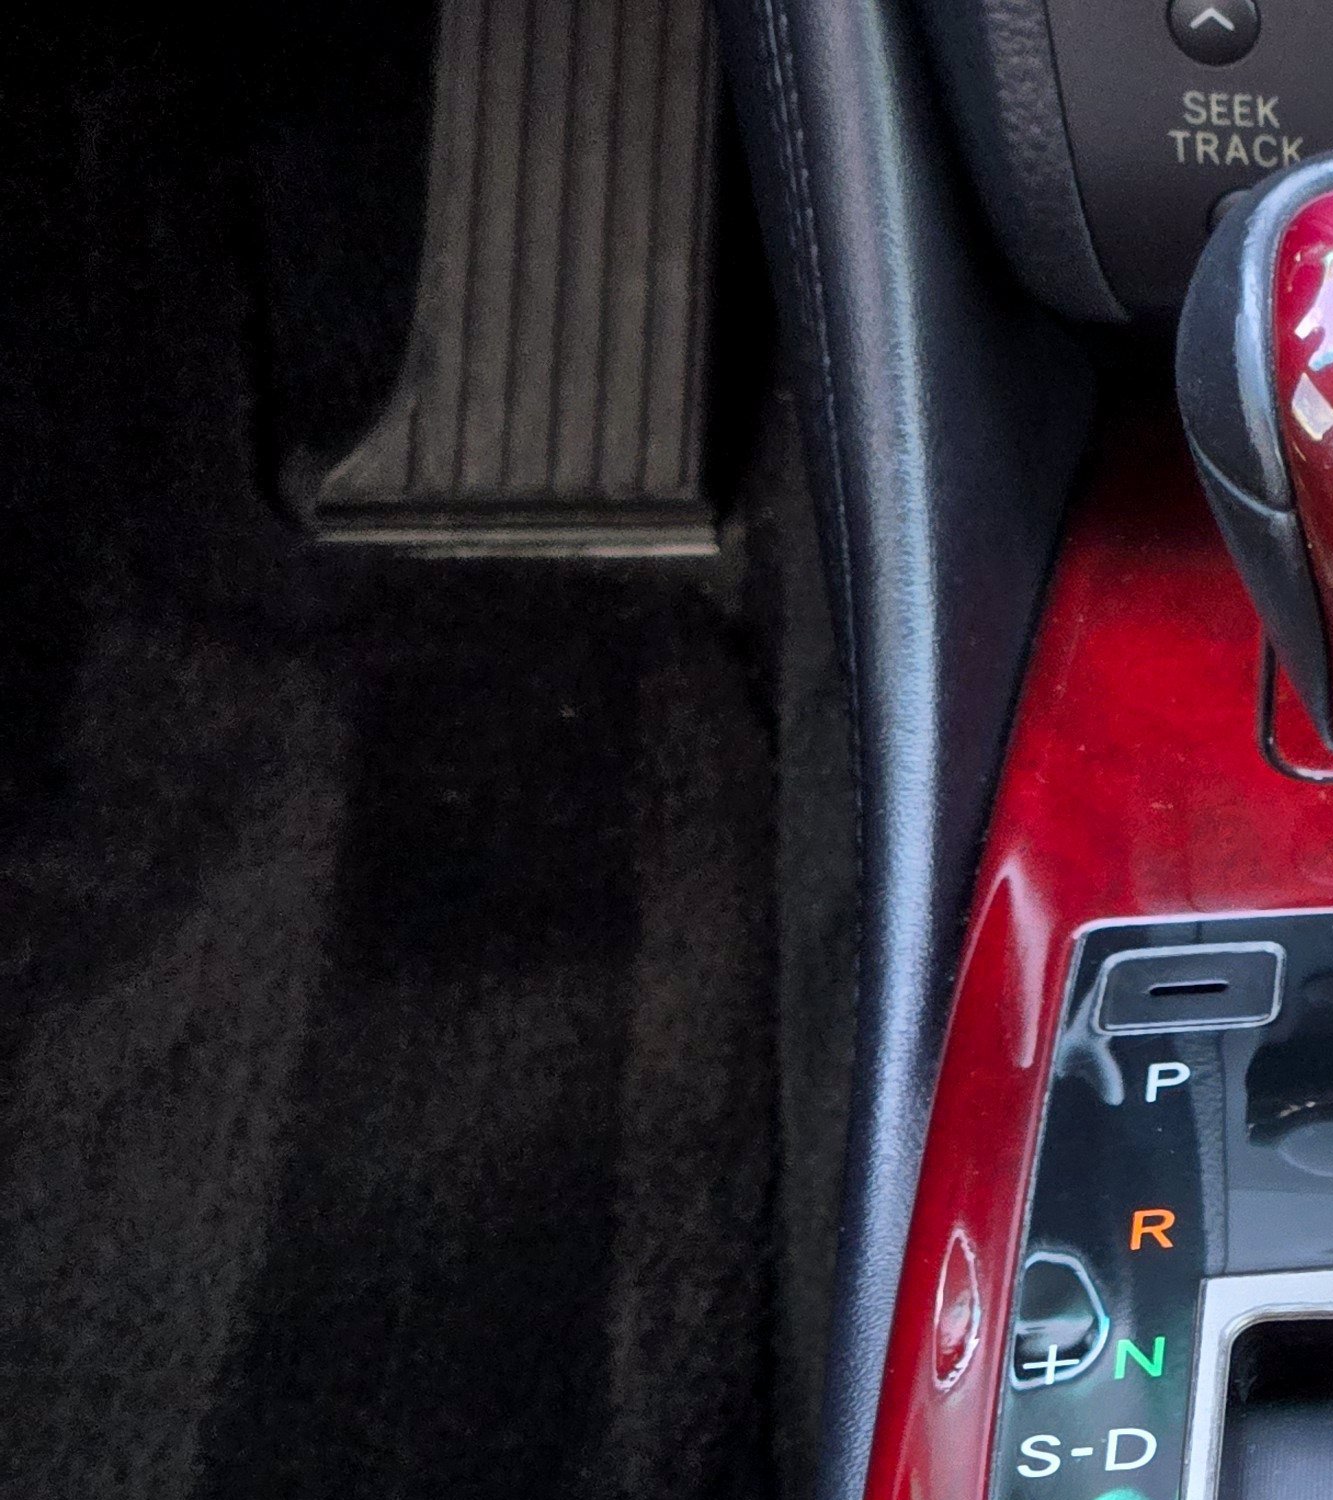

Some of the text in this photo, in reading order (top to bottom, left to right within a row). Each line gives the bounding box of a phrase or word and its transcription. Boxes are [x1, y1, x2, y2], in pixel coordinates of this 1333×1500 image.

[1182, 90, 1280, 129] SEEK
[1167, 129, 1304, 168] TRACK
[1145, 1061, 1191, 1103] P
[1129, 1208, 1176, 1251] R
[1114, 1336, 1166, 1380] N
